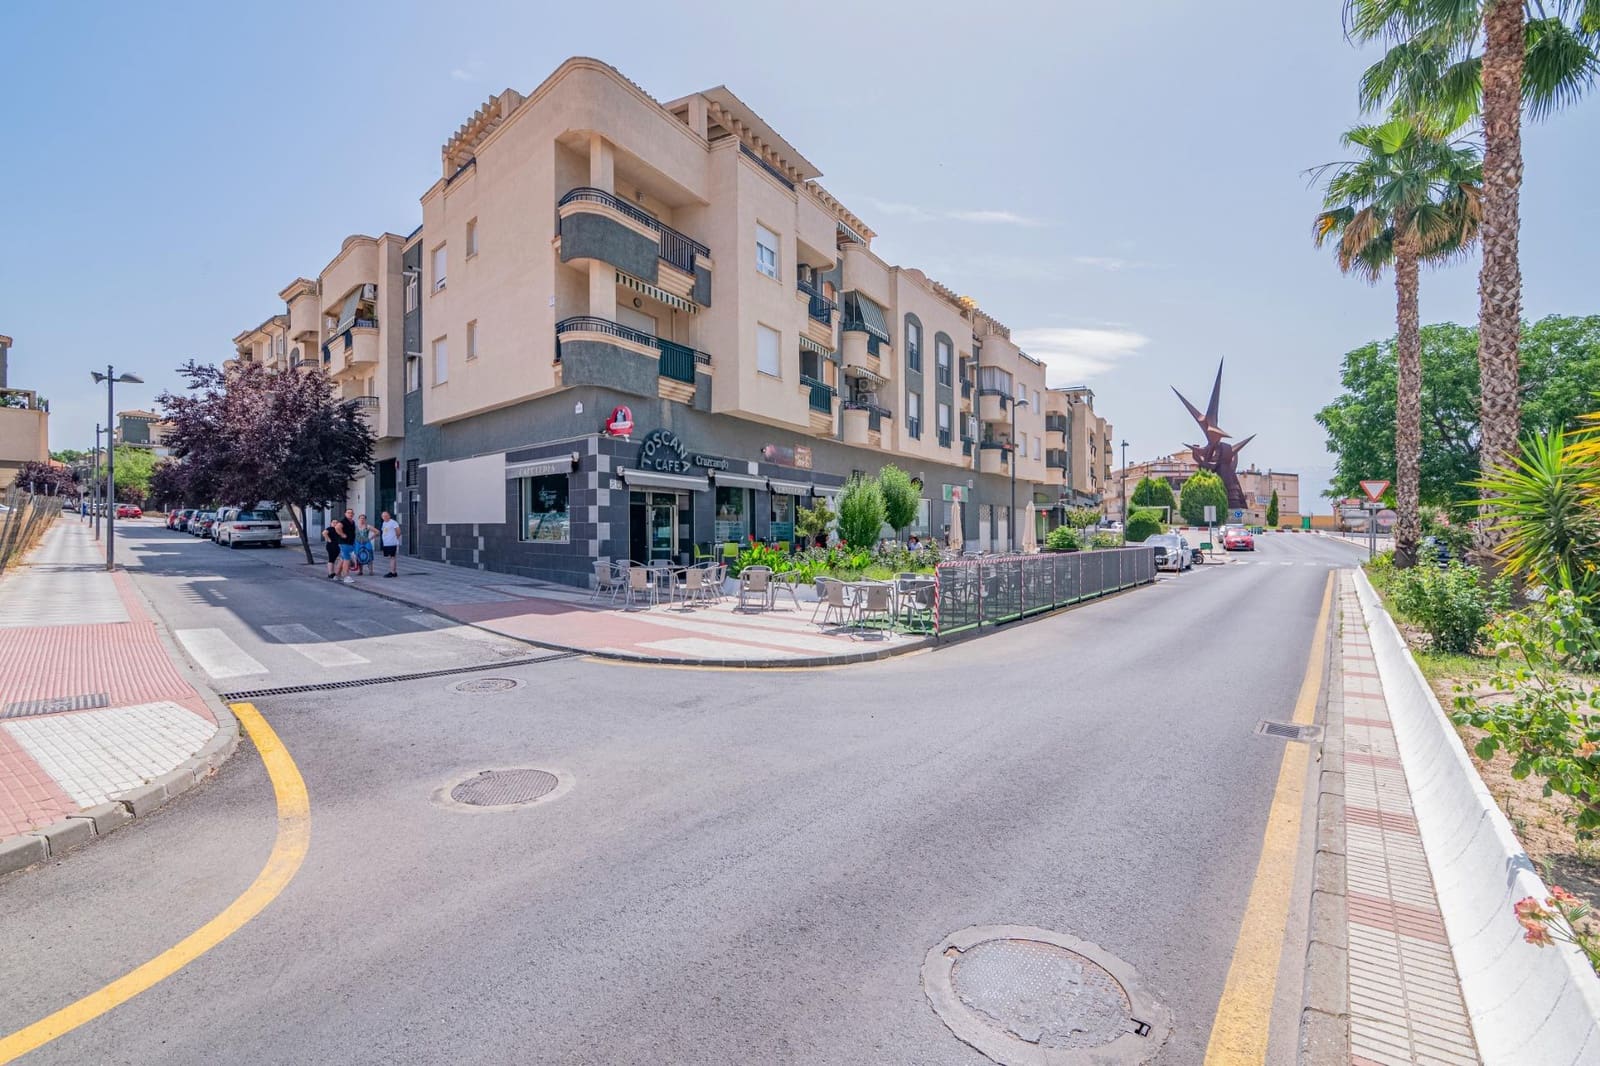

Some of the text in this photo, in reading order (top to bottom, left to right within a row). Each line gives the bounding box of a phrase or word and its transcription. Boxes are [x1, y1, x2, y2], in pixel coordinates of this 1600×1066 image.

[641, 430, 691, 472] TOSCANA
[655, 458, 681, 472] CAFE
[696, 455, 729, 471] Cruzcampo
